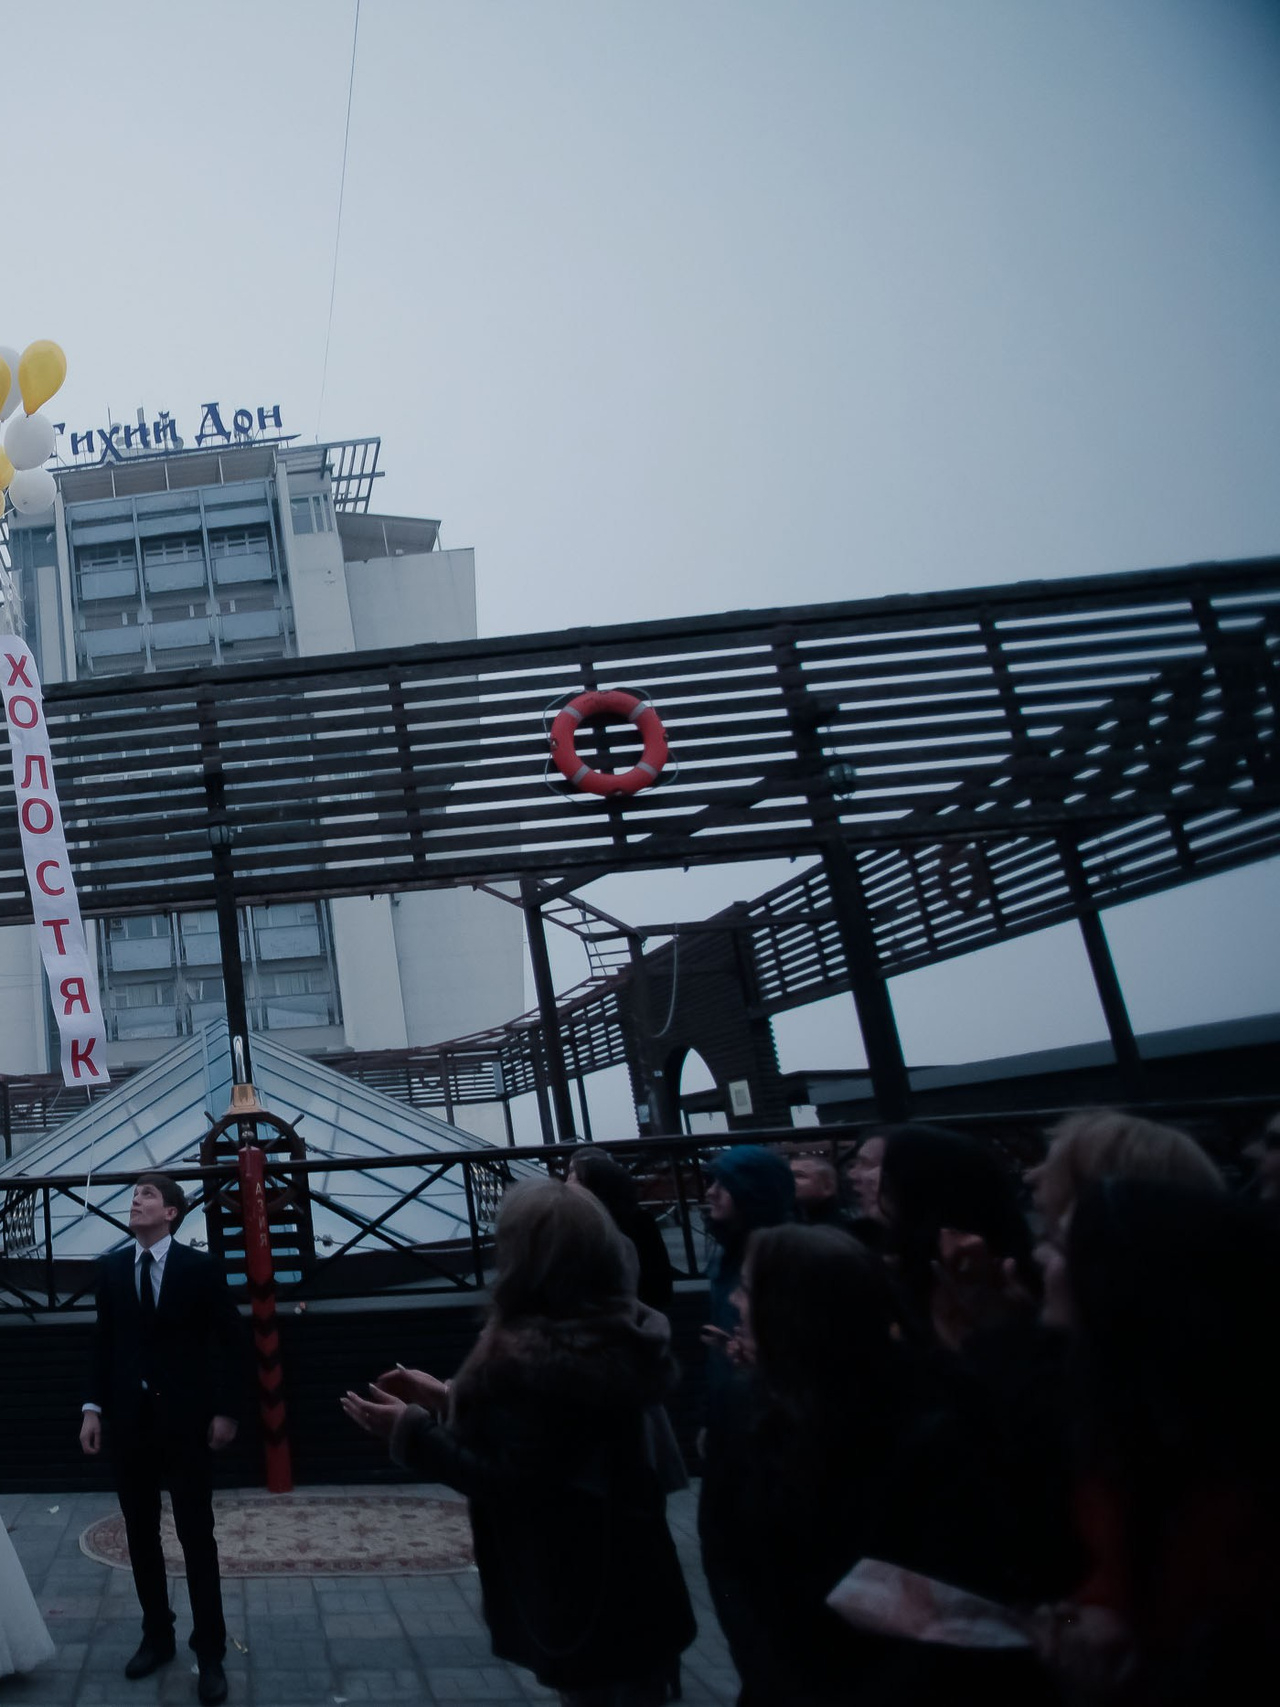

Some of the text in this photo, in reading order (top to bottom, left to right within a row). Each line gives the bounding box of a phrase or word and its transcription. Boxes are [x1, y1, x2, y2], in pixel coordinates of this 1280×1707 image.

[195, 402, 283, 446] Дон
[3, 653, 99, 1078] ХОЛОСТЯК
[255, 1181, 268, 1247] АЗИЯ
